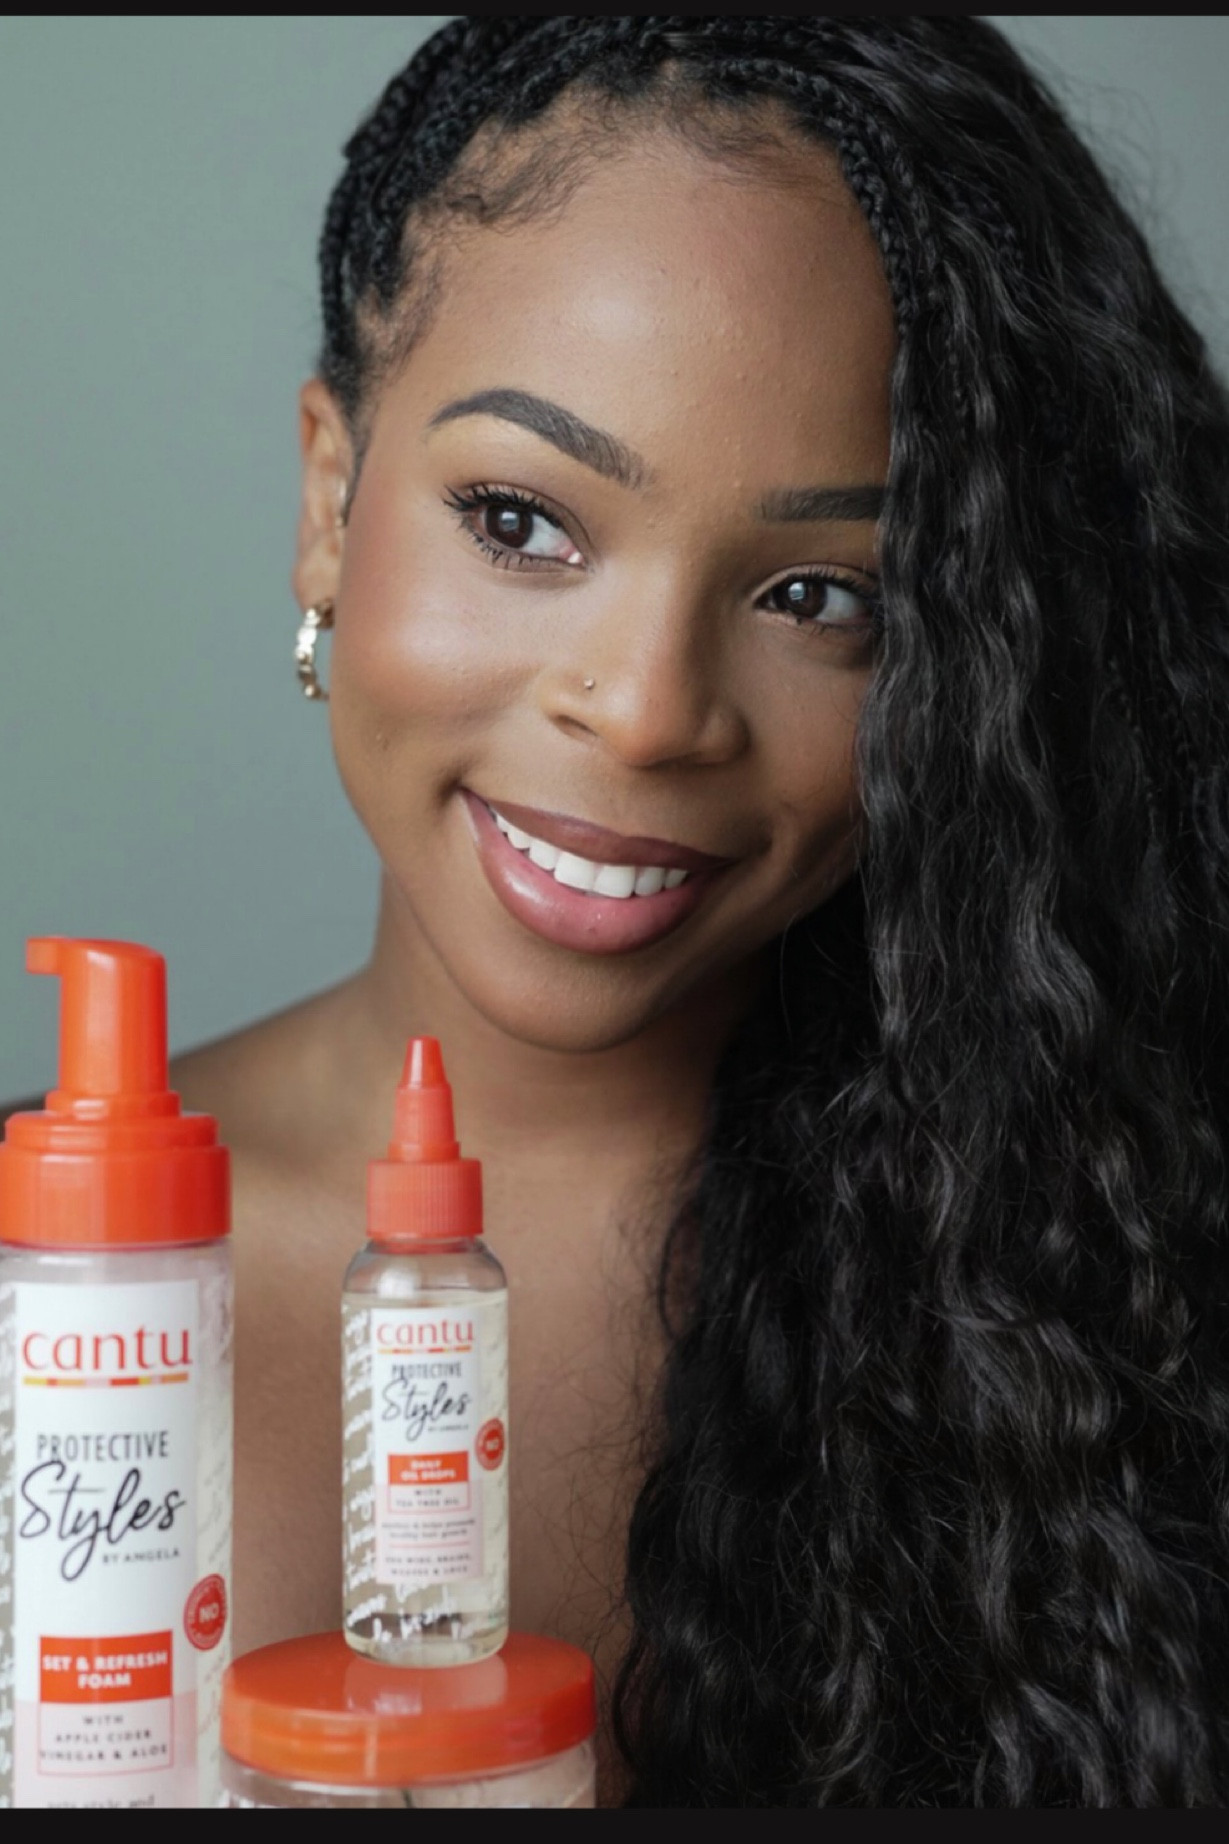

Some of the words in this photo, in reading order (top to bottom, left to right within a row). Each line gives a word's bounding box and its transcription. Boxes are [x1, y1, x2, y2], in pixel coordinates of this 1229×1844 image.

[377, 1320, 475, 1345] cantu
[23, 1326, 192, 1370] cantu
[381, 1377, 472, 1442] Styles
[37, 1431, 169, 1462] PROTECTIVE
[19, 1460, 186, 1582] Styles
[124, 1548, 180, 1562] ANGELA
[199, 1602, 220, 1623] NO
[43, 1655, 70, 1671] SET
[76, 1656, 90, 1671] &
[95, 1652, 168, 1670] REFRESH
[78, 1673, 131, 1689] FOAM
[83, 1715, 124, 1725] WITH
[56, 1732, 99, 1743] APPLE
[107, 1729, 152, 1742] CIDER
[40, 1750, 104, 1761] VINEGAR
[131, 1744, 168, 1758] ALOE
